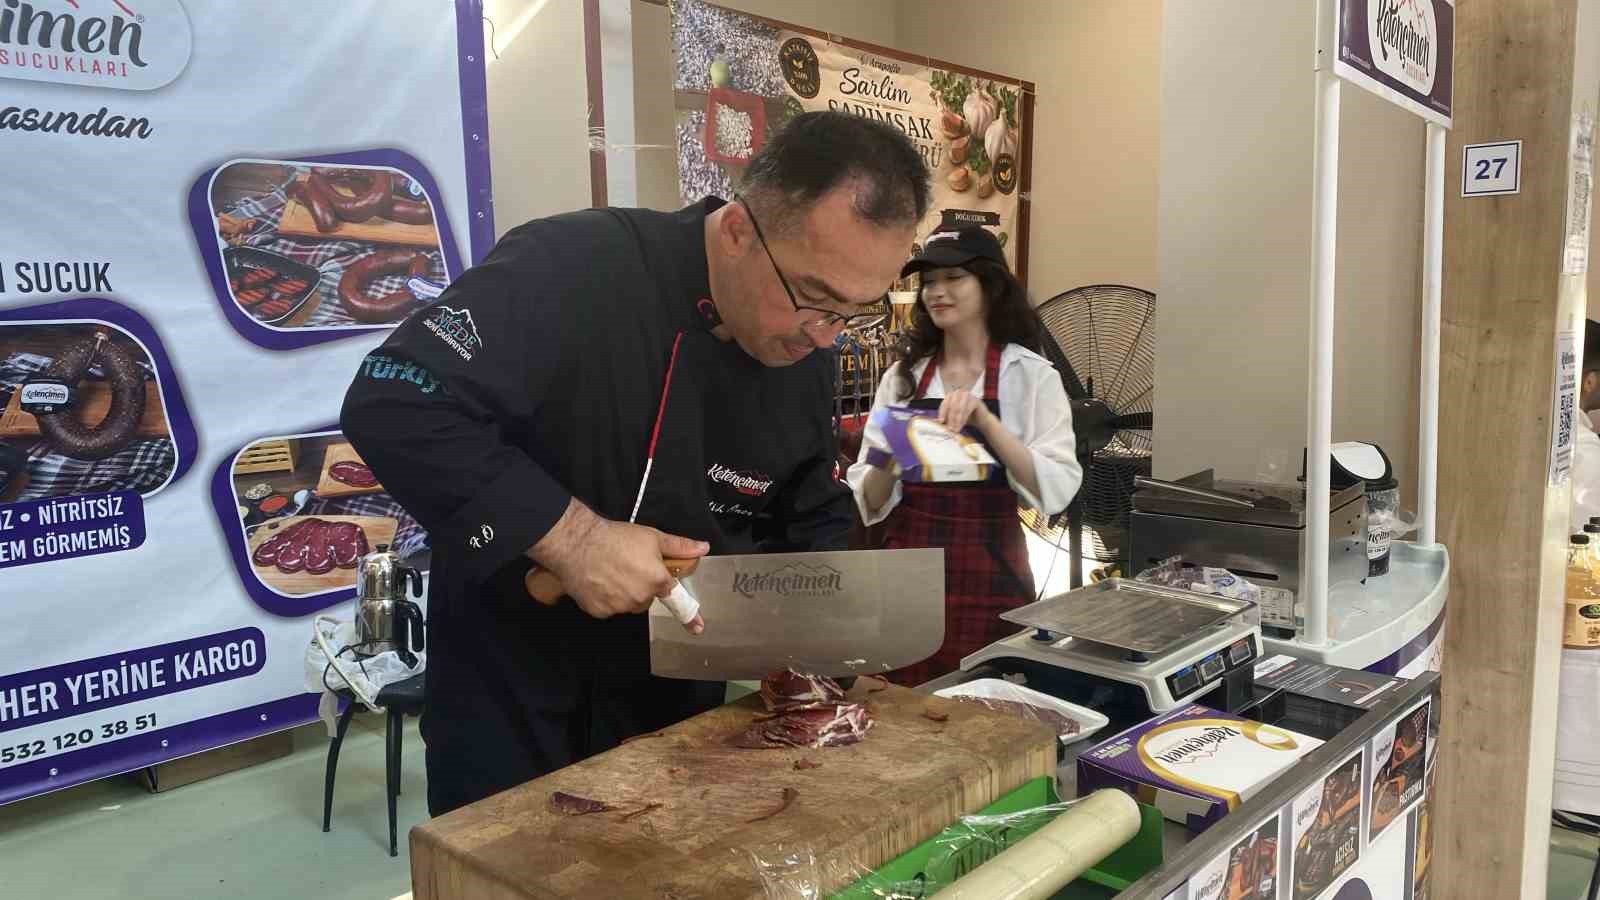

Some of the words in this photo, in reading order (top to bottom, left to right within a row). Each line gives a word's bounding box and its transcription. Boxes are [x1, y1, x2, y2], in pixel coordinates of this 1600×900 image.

[0, 49, 128, 77] SUCUKLARI
[840, 68, 911, 104] Sarlim
[0, 106, 153, 139] asından
[1474, 157, 1508, 180] 27
[15, 262, 113, 293] SUCUK
[38, 494, 124, 526] NİTRİTSİZ
[33, 522, 131, 557] GÖRMEMİŞ
[0, 681, 59, 722] HER
[64, 659, 166, 706] YERİNE
[174, 638, 257, 682] KARGO
[0, 740, 46, 763] 532
[53, 729, 94, 750] 120
[101, 720, 129, 739] 38
[135, 712, 157, 731] 51
